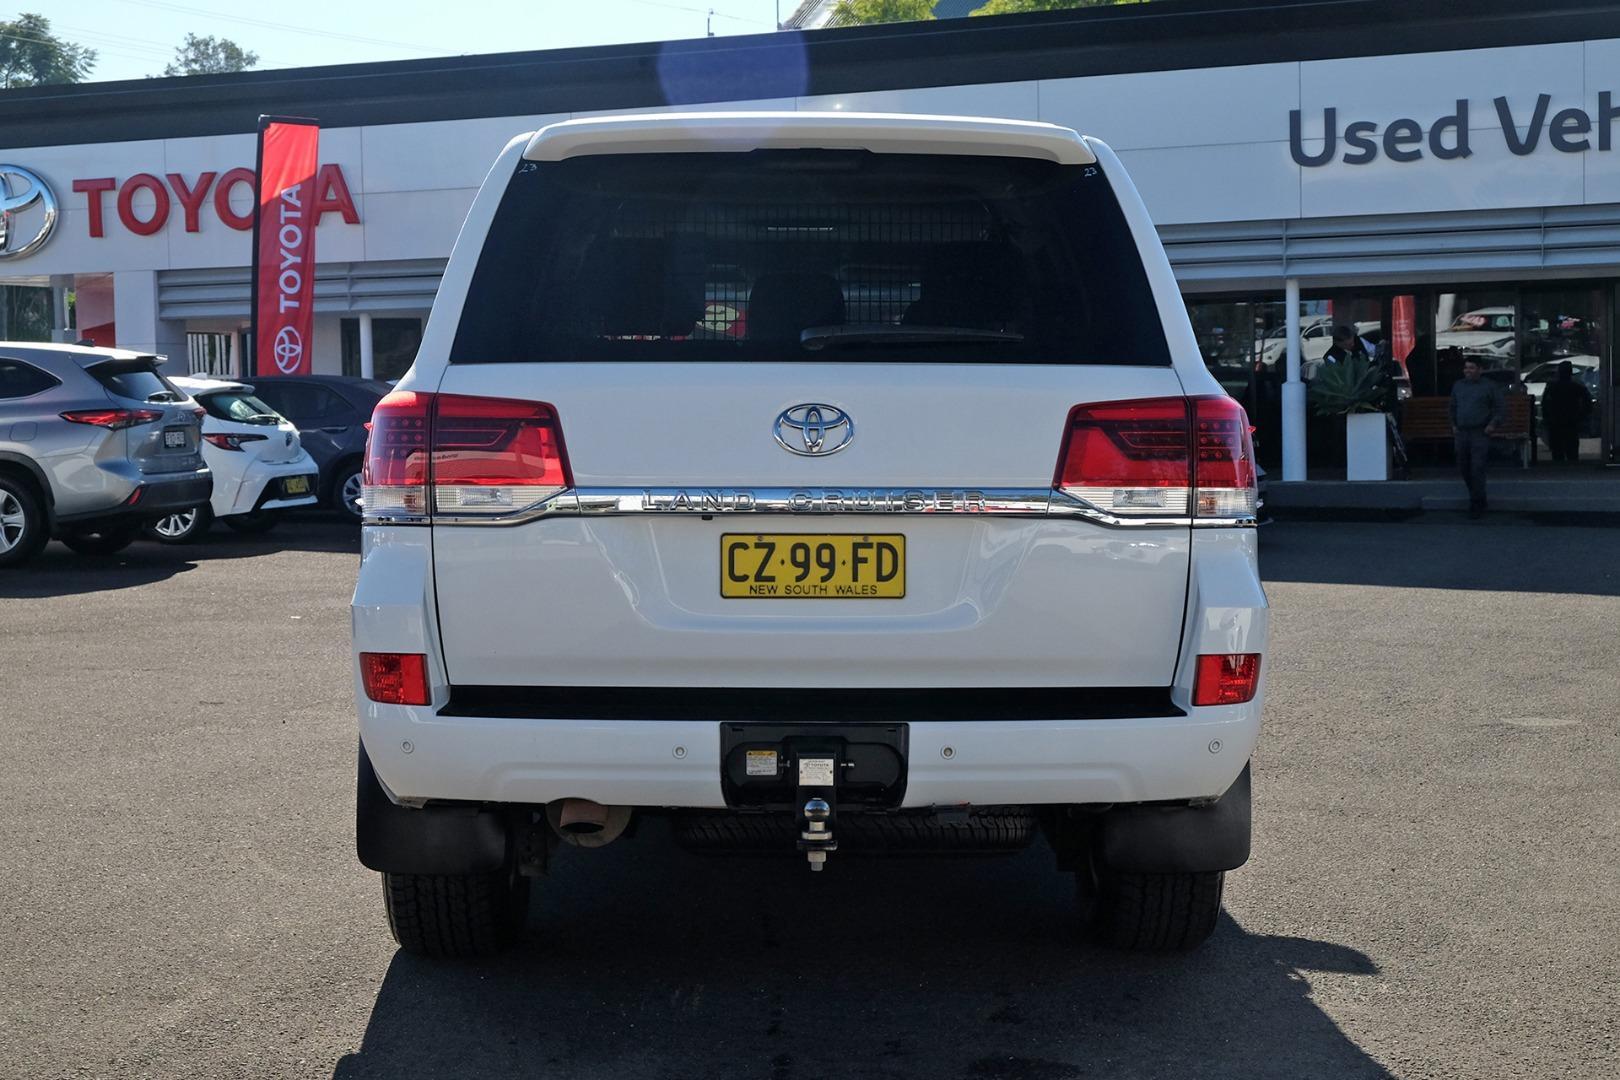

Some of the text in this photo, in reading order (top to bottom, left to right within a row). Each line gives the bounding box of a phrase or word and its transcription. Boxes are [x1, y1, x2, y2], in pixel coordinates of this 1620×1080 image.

[1288, 98, 1473, 167] Used
[1084, 167, 1098, 177] 23
[72, 163, 361, 238] TOYOA
[278, 183, 303, 314] TOYOTA
[641, 489, 987, 512] LAND CRUISER
[749, 585, 878, 595] NEW SOUTH WALES
